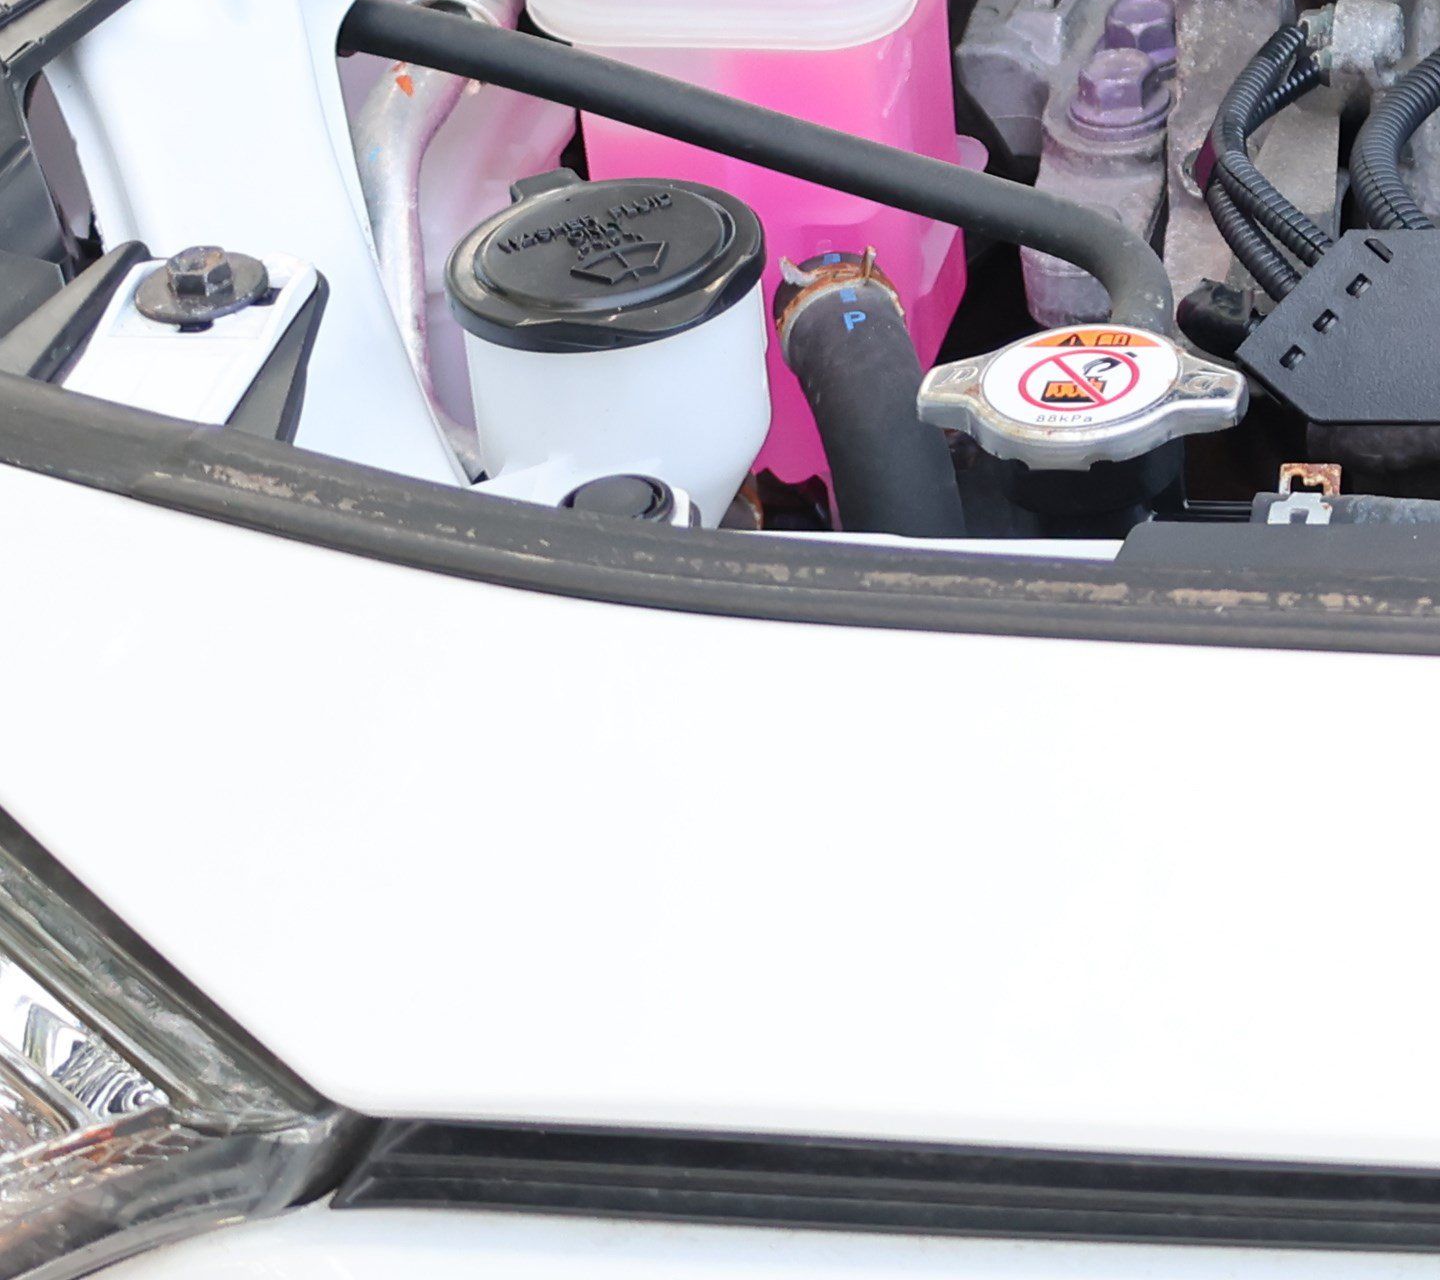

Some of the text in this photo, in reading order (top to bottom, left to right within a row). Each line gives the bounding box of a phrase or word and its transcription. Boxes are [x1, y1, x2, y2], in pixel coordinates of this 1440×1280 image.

[497, 214, 600, 255] WASHER
[843, 310, 867, 331] P
[1036, 413, 1093, 424] 88kPa
